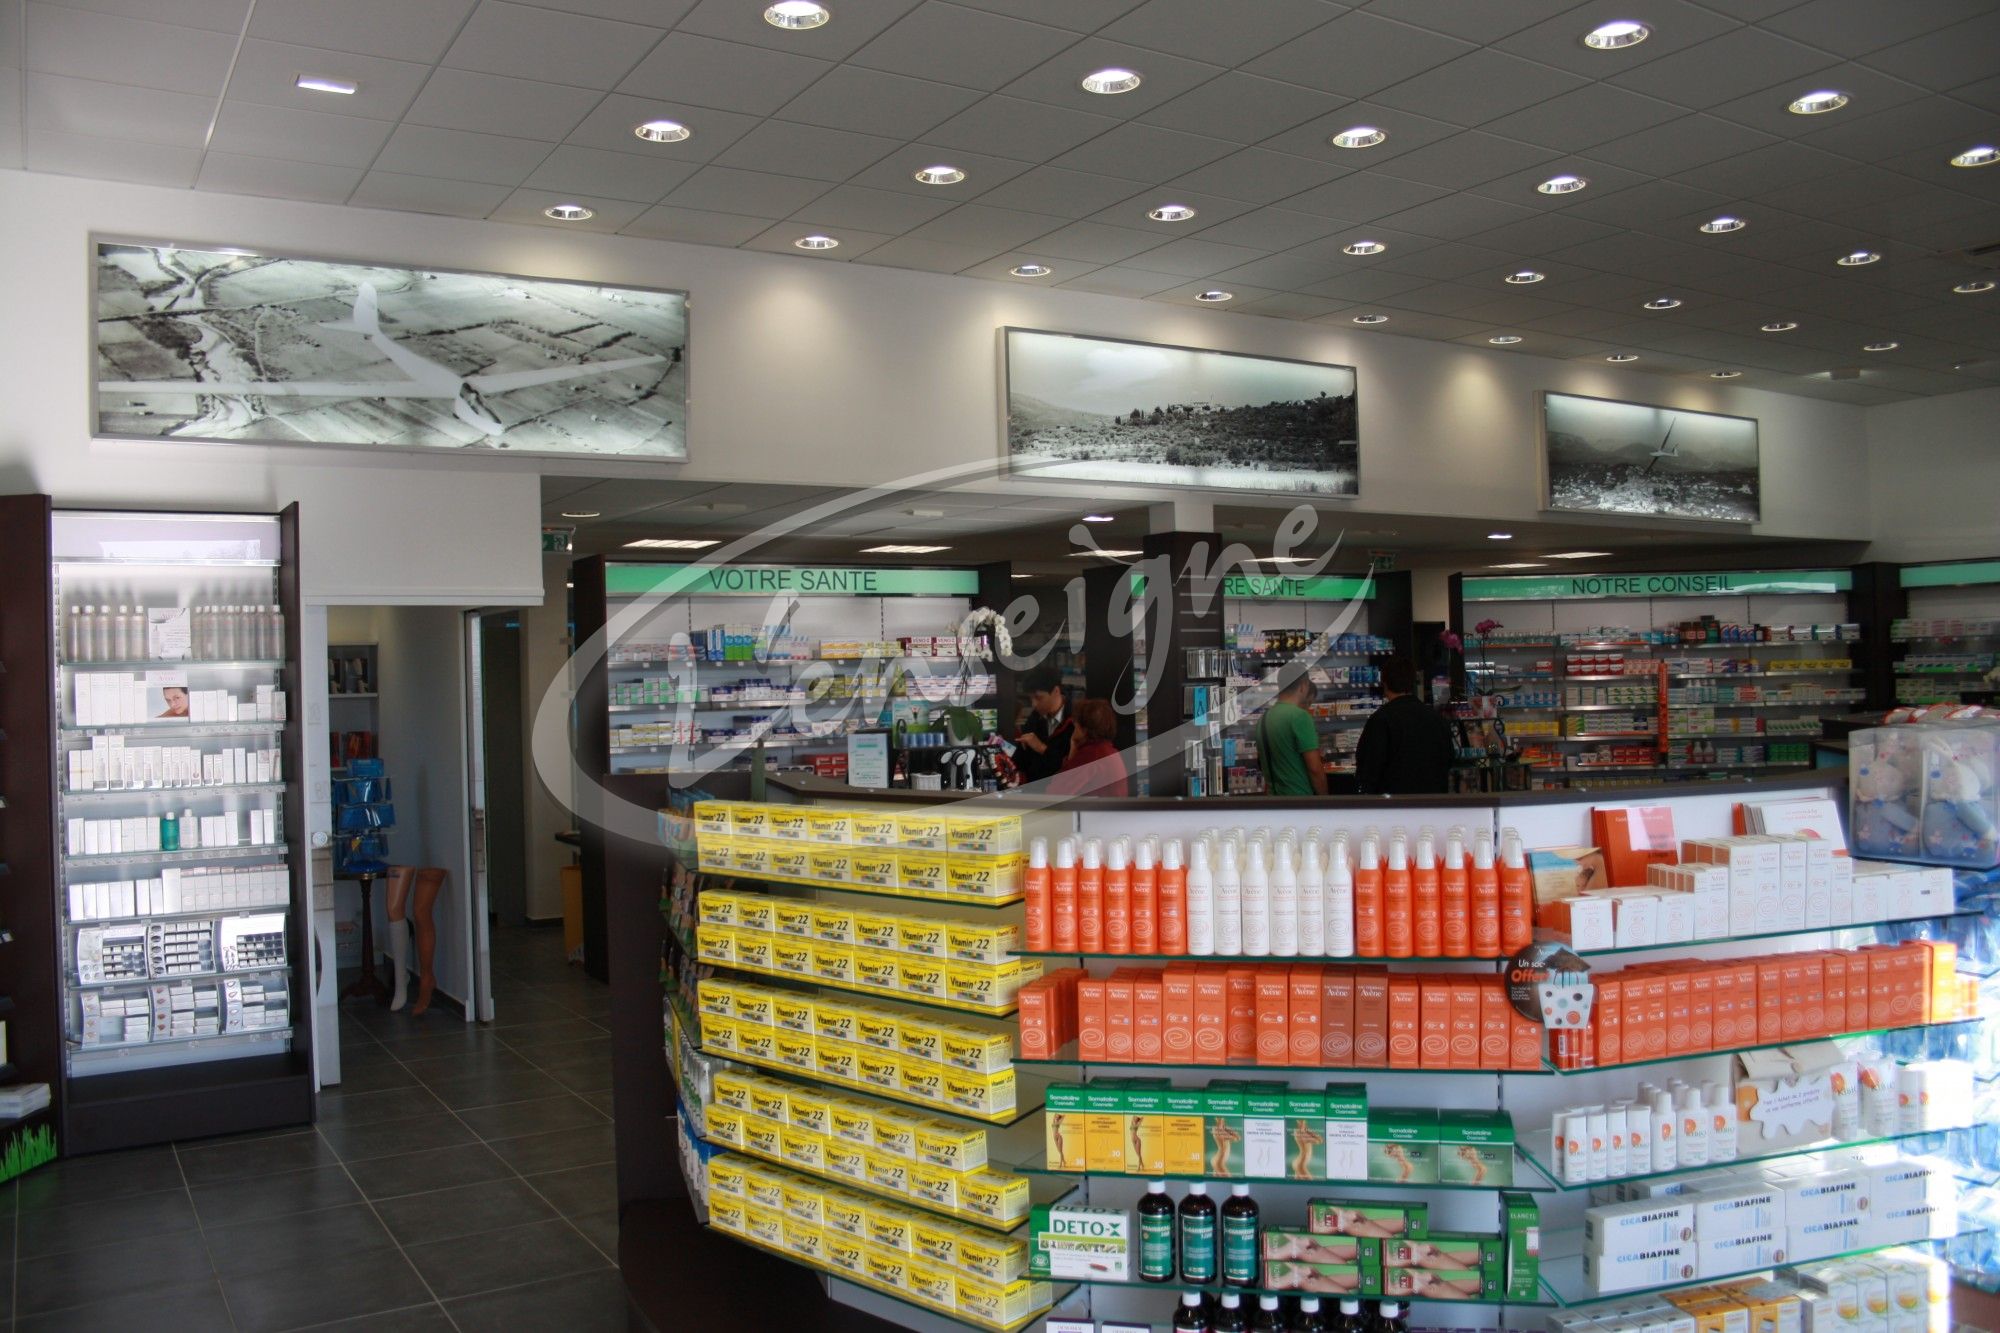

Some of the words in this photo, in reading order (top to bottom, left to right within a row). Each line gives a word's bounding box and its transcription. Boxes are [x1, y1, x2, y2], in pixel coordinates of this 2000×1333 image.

[710, 569, 792, 590] VOTRE
[800, 570, 877, 591] SANTE
[1251, 578, 1305, 596] SANTE
[1572, 578, 1640, 594] NOTRE
[1648, 576, 1734, 592] CONSEIL
[1519, 960, 1529, 968] Un
[1328, 989, 1348, 997] Avène
[1361, 989, 1382, 997] Avène
[1885, 1169, 1936, 1183] CICABIAFIN
[1800, 1182, 1856, 1197] CICABIAFINE
[1714, 1197, 1771, 1212] CICABIAFINE
[1621, 1210, 1679, 1226] CICABIAFINE
[1887, 1206, 1940, 1219] CICABIAFIN
[1804, 1218, 1859, 1233] CICABIAFINE
[1715, 1234, 1772, 1249] CICABIAFINE
[1617, 1248, 1680, 1263] CICABIAFINE
